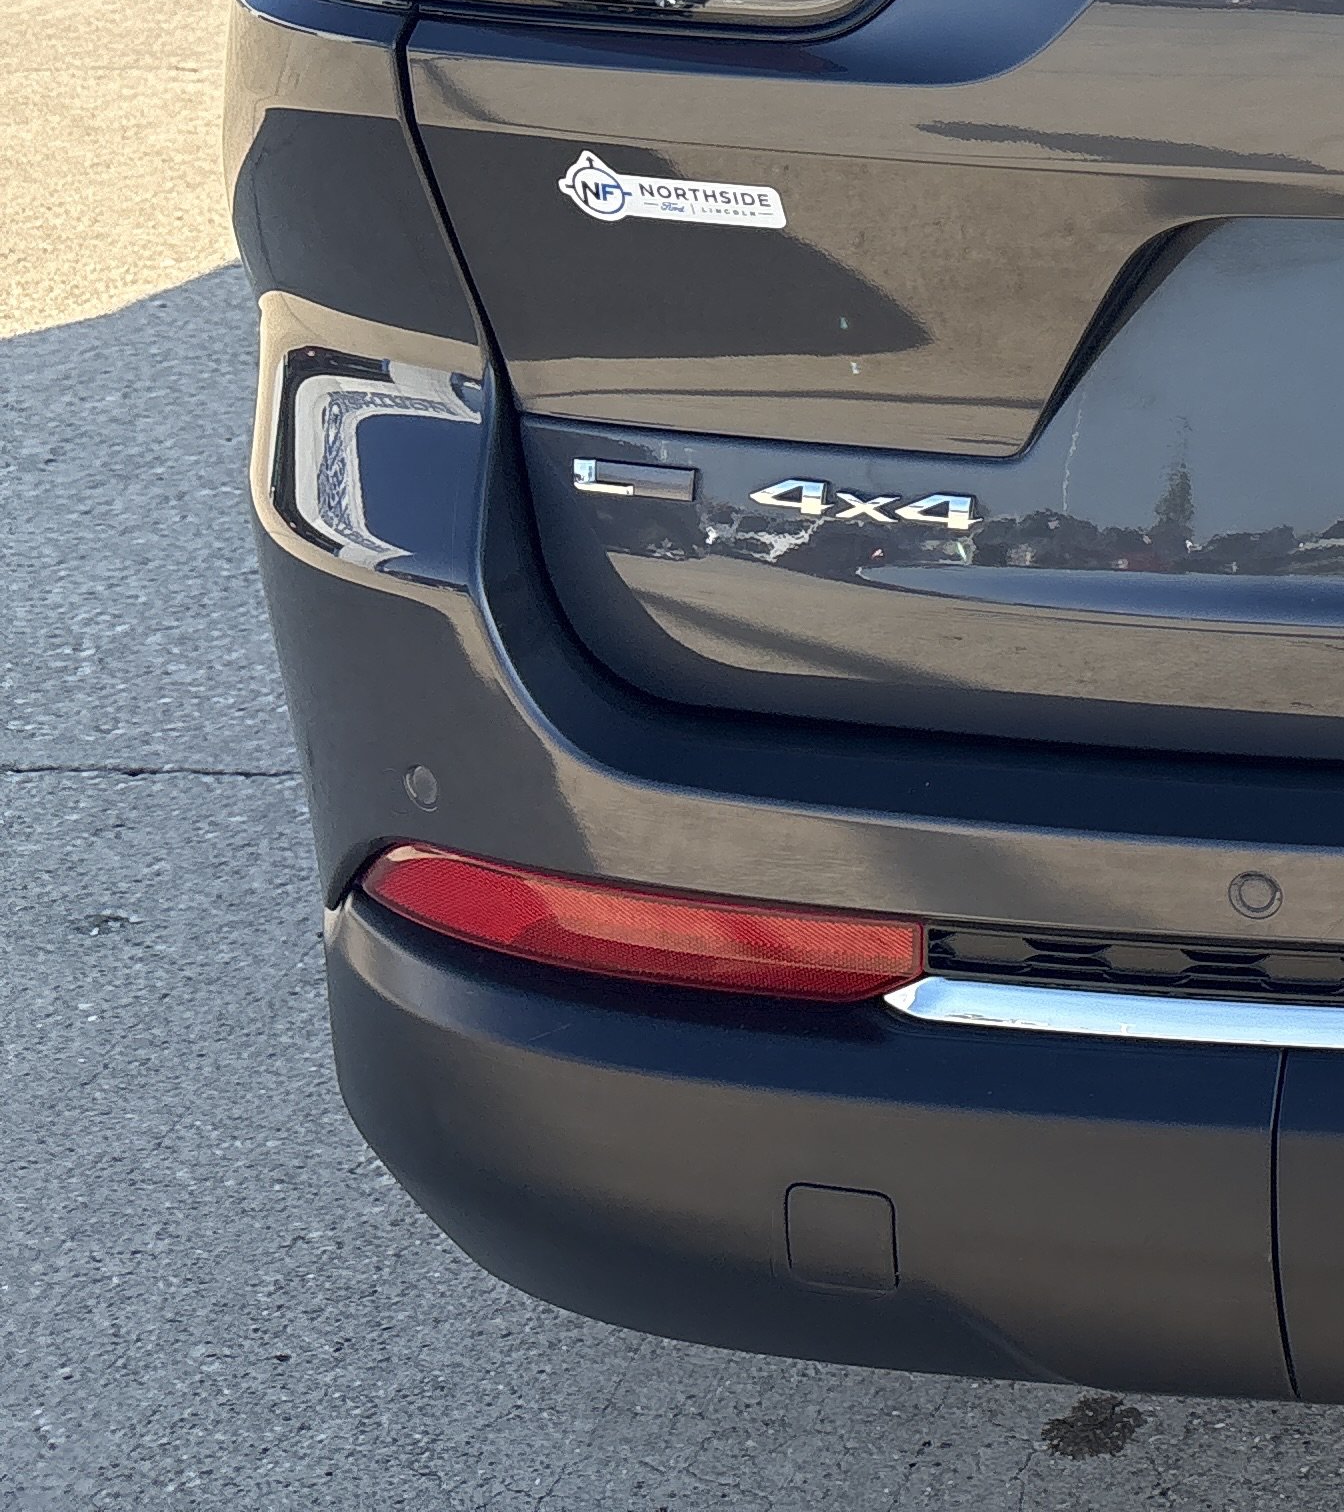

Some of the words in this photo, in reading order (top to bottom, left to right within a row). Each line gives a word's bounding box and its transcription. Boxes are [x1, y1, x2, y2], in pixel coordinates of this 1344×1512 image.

[580, 180, 621, 206] NF
[638, 183, 772, 207] NORTHSIDE
[661, 201, 686, 214] Ford
[701, 207, 756, 217] LINCOLN
[750, 479, 984, 530] 4x4
